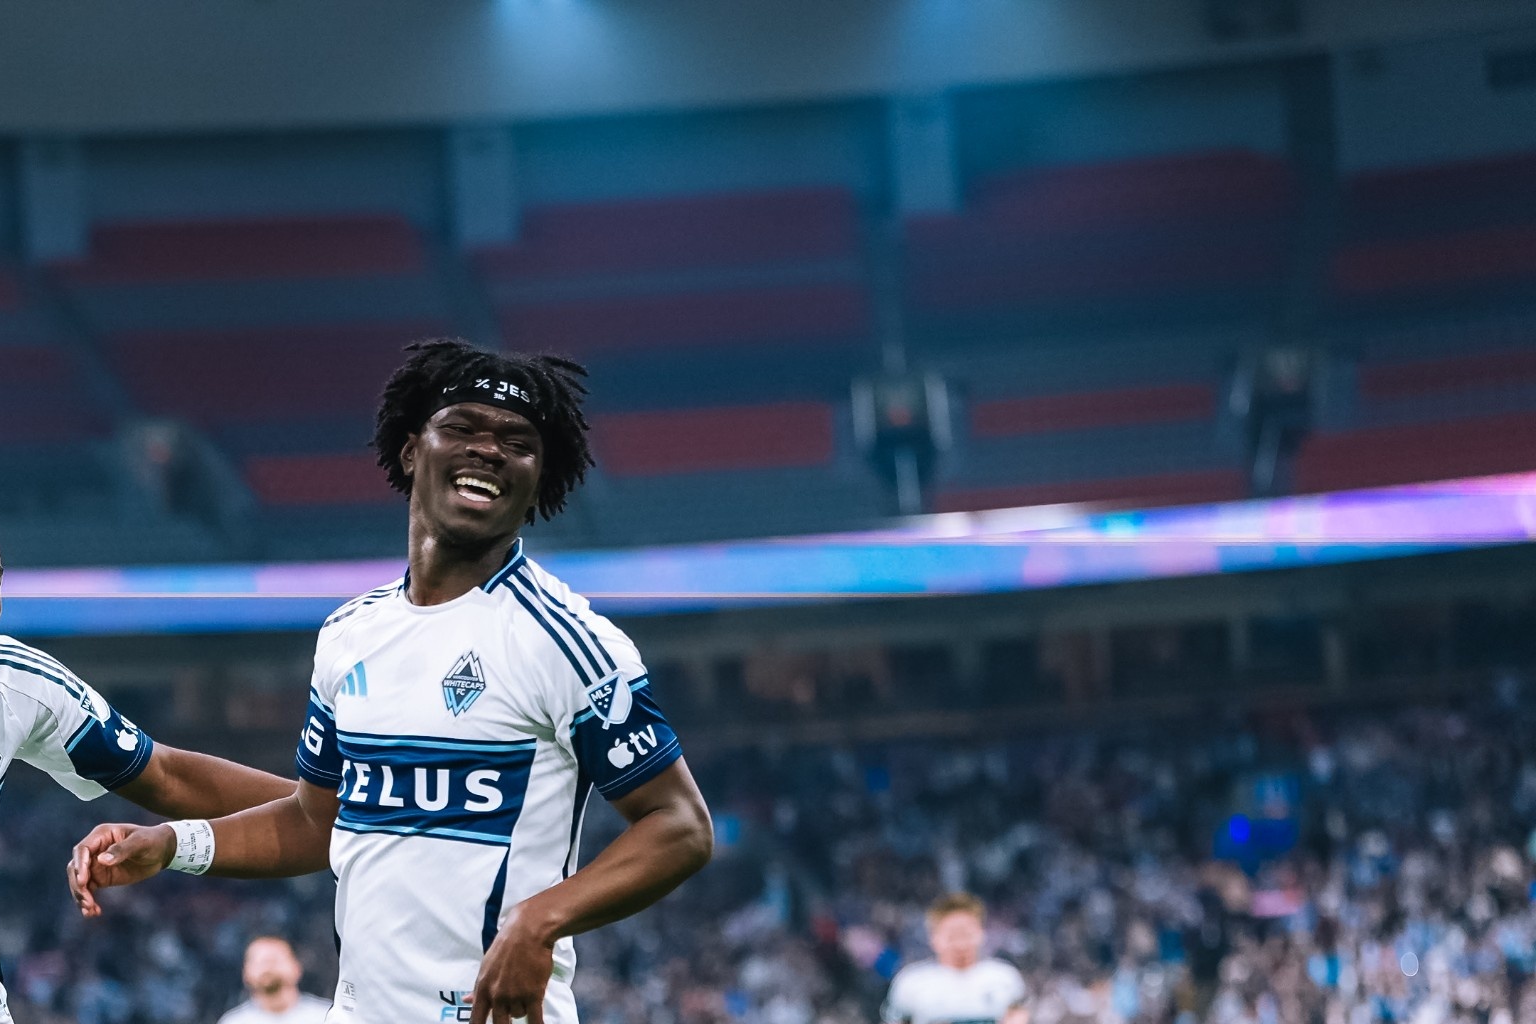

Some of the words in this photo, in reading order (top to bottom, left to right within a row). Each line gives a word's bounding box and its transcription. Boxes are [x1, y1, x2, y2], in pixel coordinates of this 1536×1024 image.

[444, 679, 484, 691] WHITECAPS
[456, 687, 466, 696] FC
[590, 684, 613, 702] MLS
